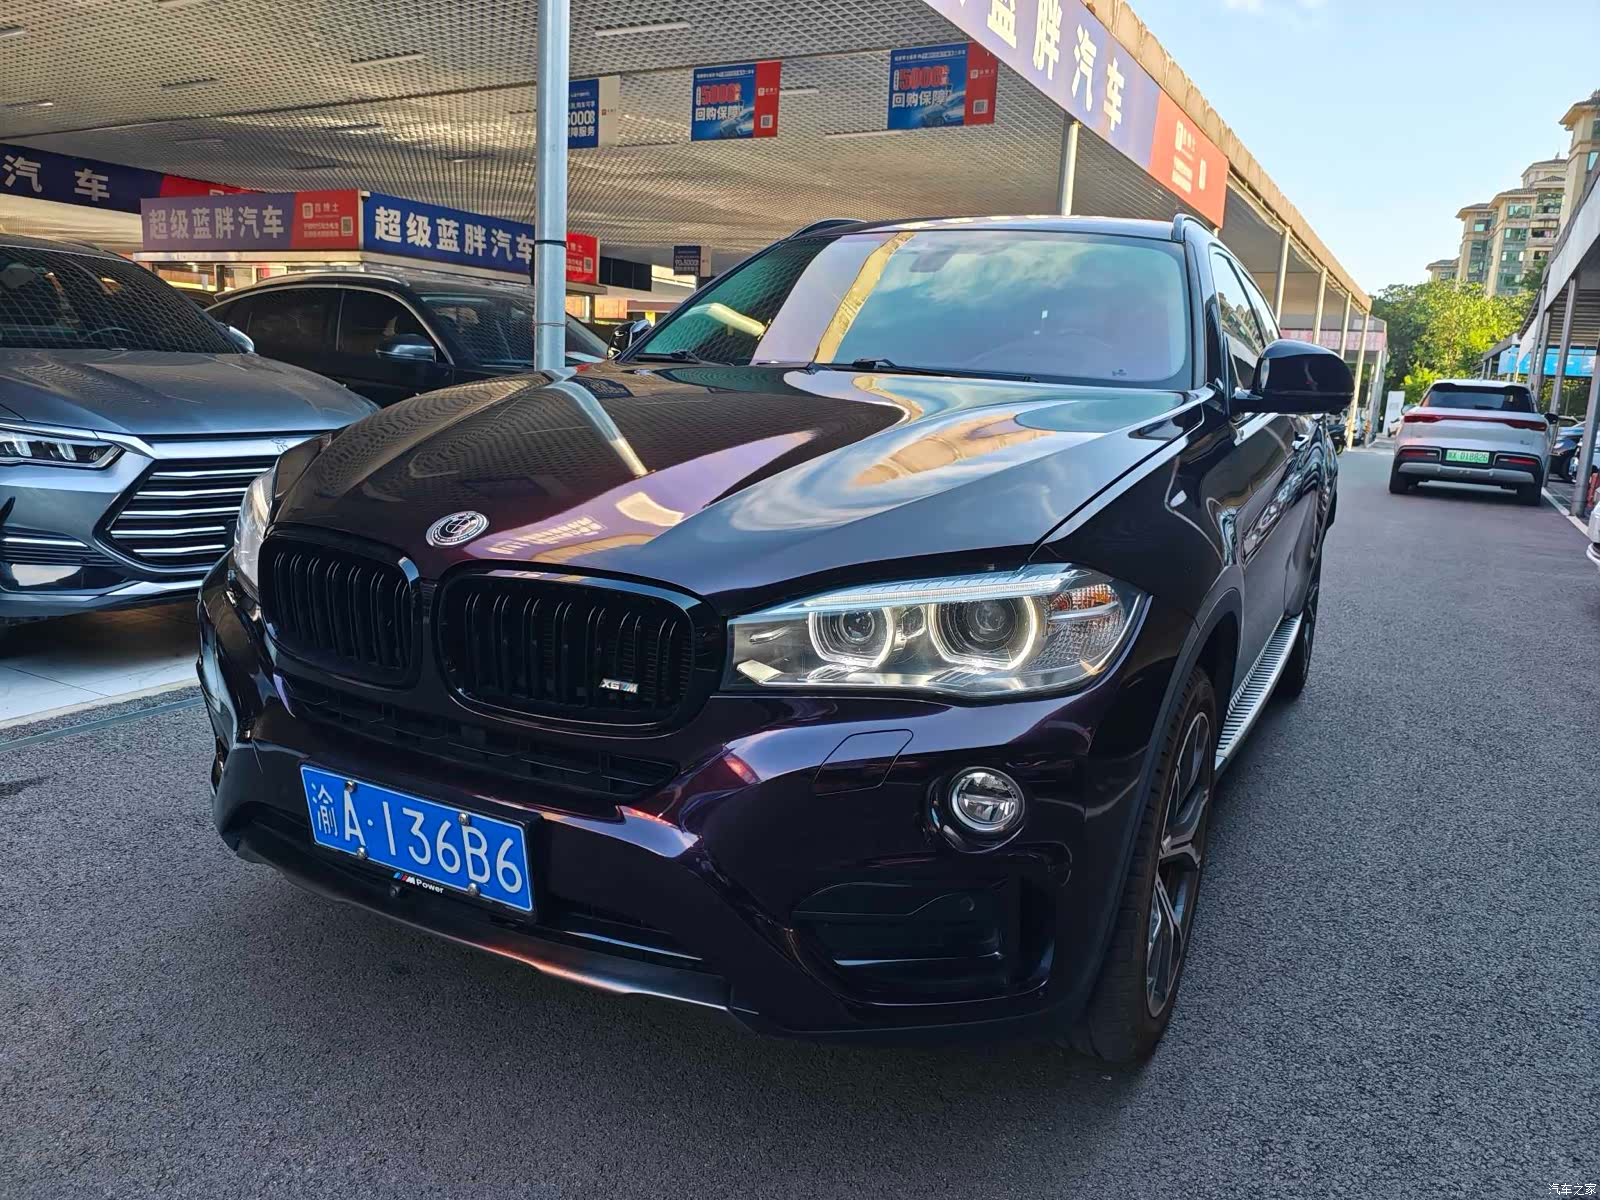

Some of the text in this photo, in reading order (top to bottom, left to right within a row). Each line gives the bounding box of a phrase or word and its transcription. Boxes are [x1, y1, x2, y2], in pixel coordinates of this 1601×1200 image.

[892, 90, 946, 108] 回购保障
[3, 154, 110, 201] 汽车
[149, 205, 285, 239] 超级蓝胖汽车
[374, 206, 534, 264] 超级蓝胖汽车
[416, 879, 445, 894] Power
